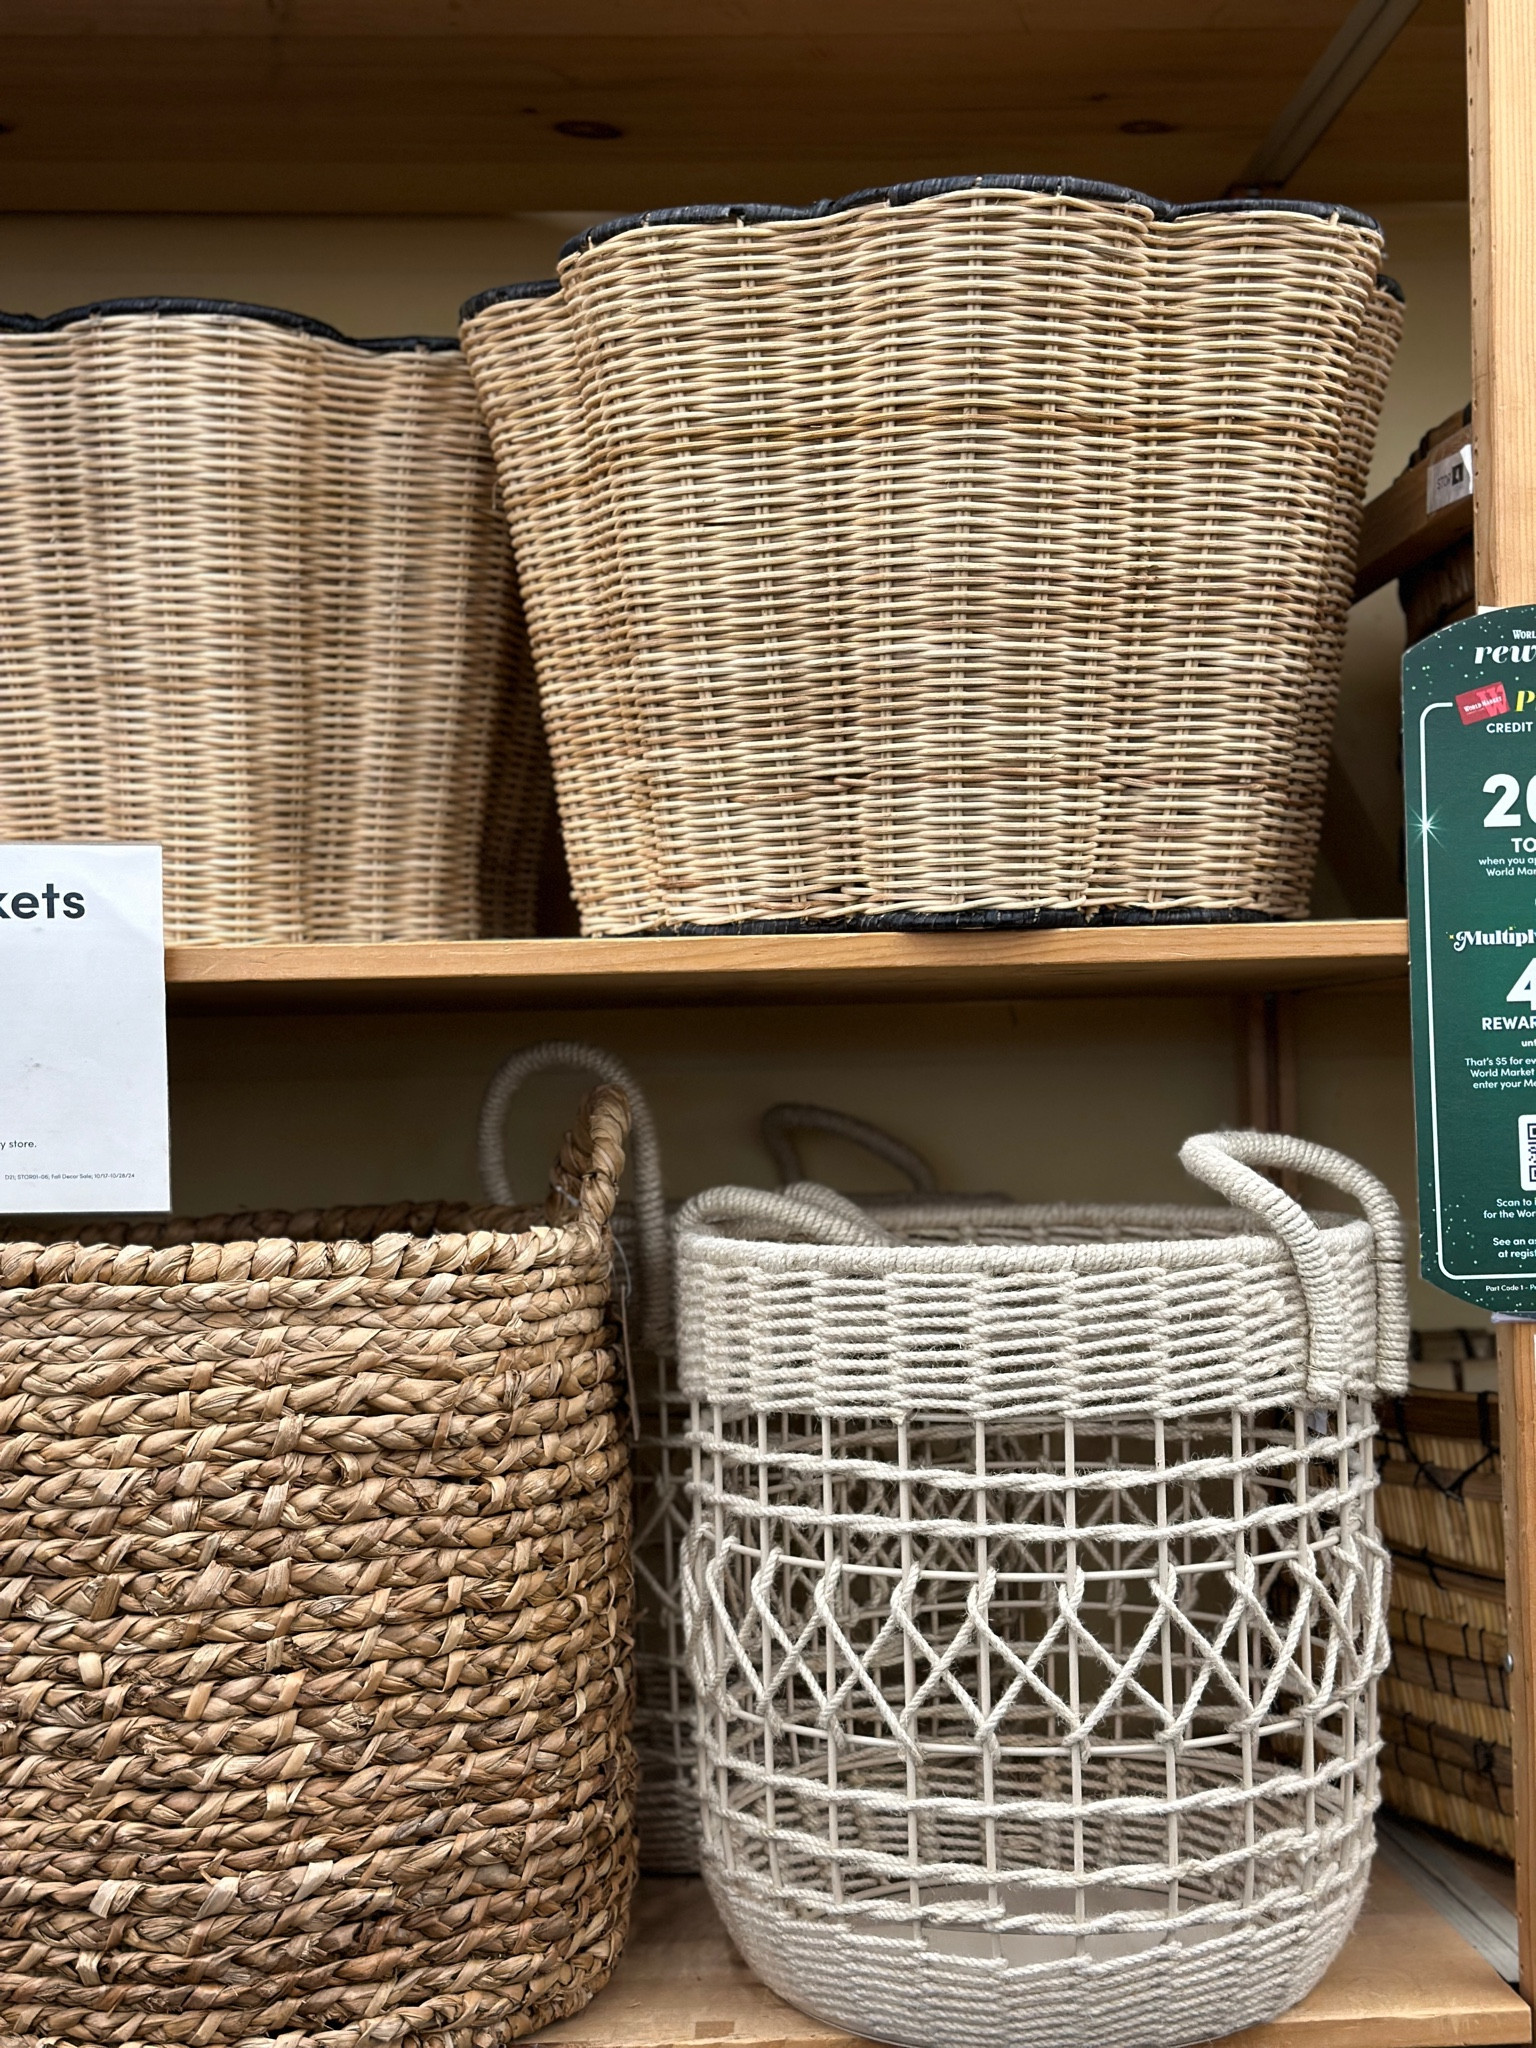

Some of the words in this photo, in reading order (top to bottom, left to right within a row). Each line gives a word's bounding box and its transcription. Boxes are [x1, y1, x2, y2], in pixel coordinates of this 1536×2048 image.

[1486, 721, 1534, 733] CREDIT
[1510, 837, 1536, 853] TO
[1478, 856, 1505, 866] when
[1507, 857, 1525, 867] you
[1485, 867, 1515, 877] World
[1453, 929, 1536, 952] Multipl
[1495, 1056, 1508, 1066] $5
[1509, 1056, 1524, 1065] for
[1470, 1068, 1499, 1078] World
[1500, 1067, 1535, 1077] Market
[1472, 1080, 1498, 1089] enter
[1500, 1081, 1522, 1091] your
[8, 1140, 37, 1149] store.
[1496, 1198, 1521, 1208] Scan
[1522, 1198, 1533, 1207] to
[1483, 1209, 1497, 1219] for
[1499, 1209, 1515, 1218] the
[1516, 1209, 1536, 1218] Wor
[1492, 1237, 1511, 1246] See
[1497, 1249, 1508, 1258] at
[1501, 1284, 1519, 1292] Code
